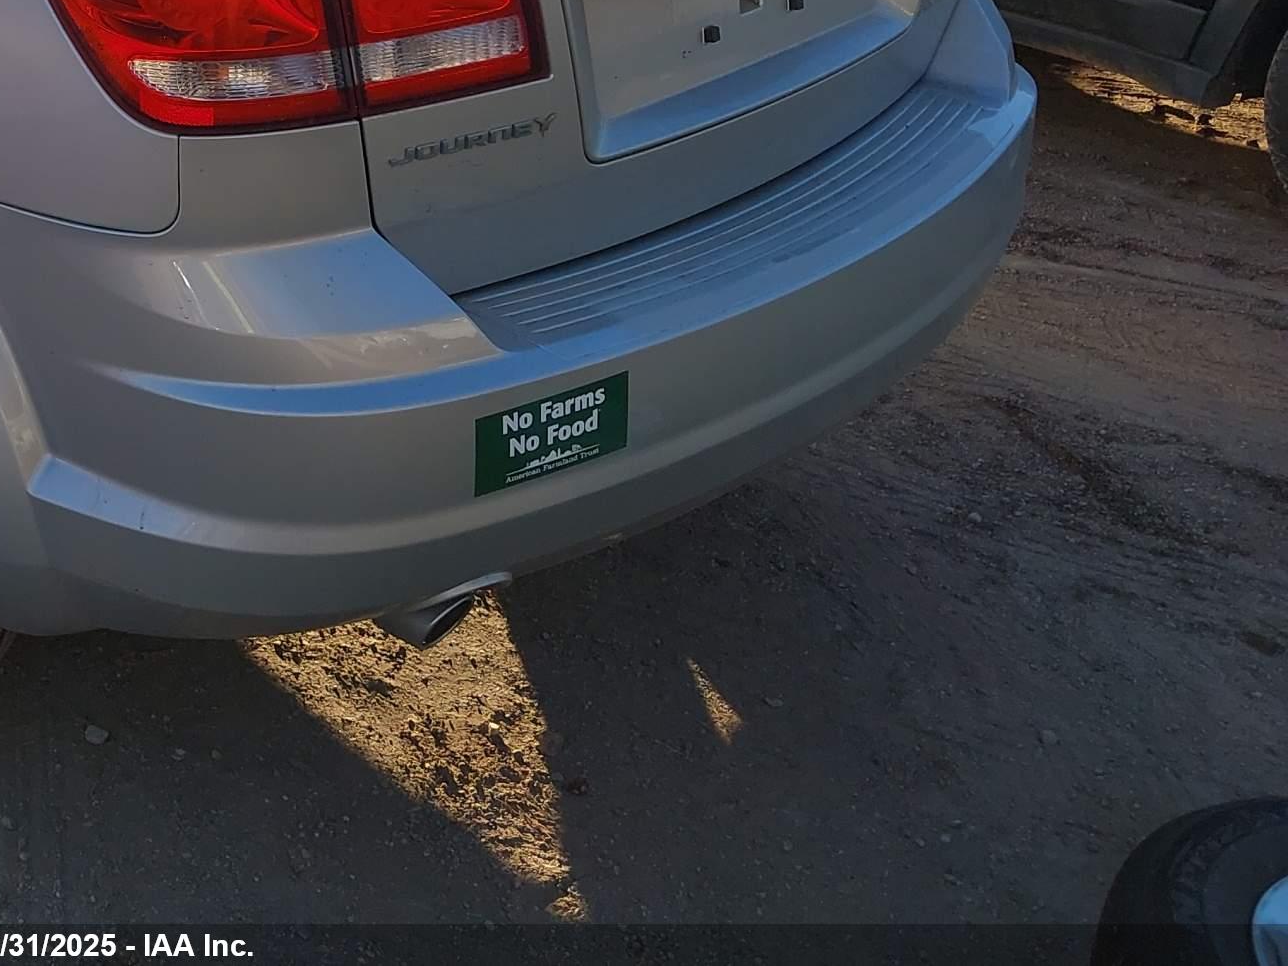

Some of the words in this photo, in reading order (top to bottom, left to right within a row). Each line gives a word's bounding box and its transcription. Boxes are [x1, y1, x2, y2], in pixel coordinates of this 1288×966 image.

[388, 112, 558, 167] JOURNEY
[502, 411, 533, 435] No
[540, 387, 606, 423] Farms
[509, 434, 540, 458] No
[547, 408, 599, 446] Food
[505, 467, 541, 483] American
[543, 454, 578, 472] Farmland
[580, 447, 600, 459] Trust
